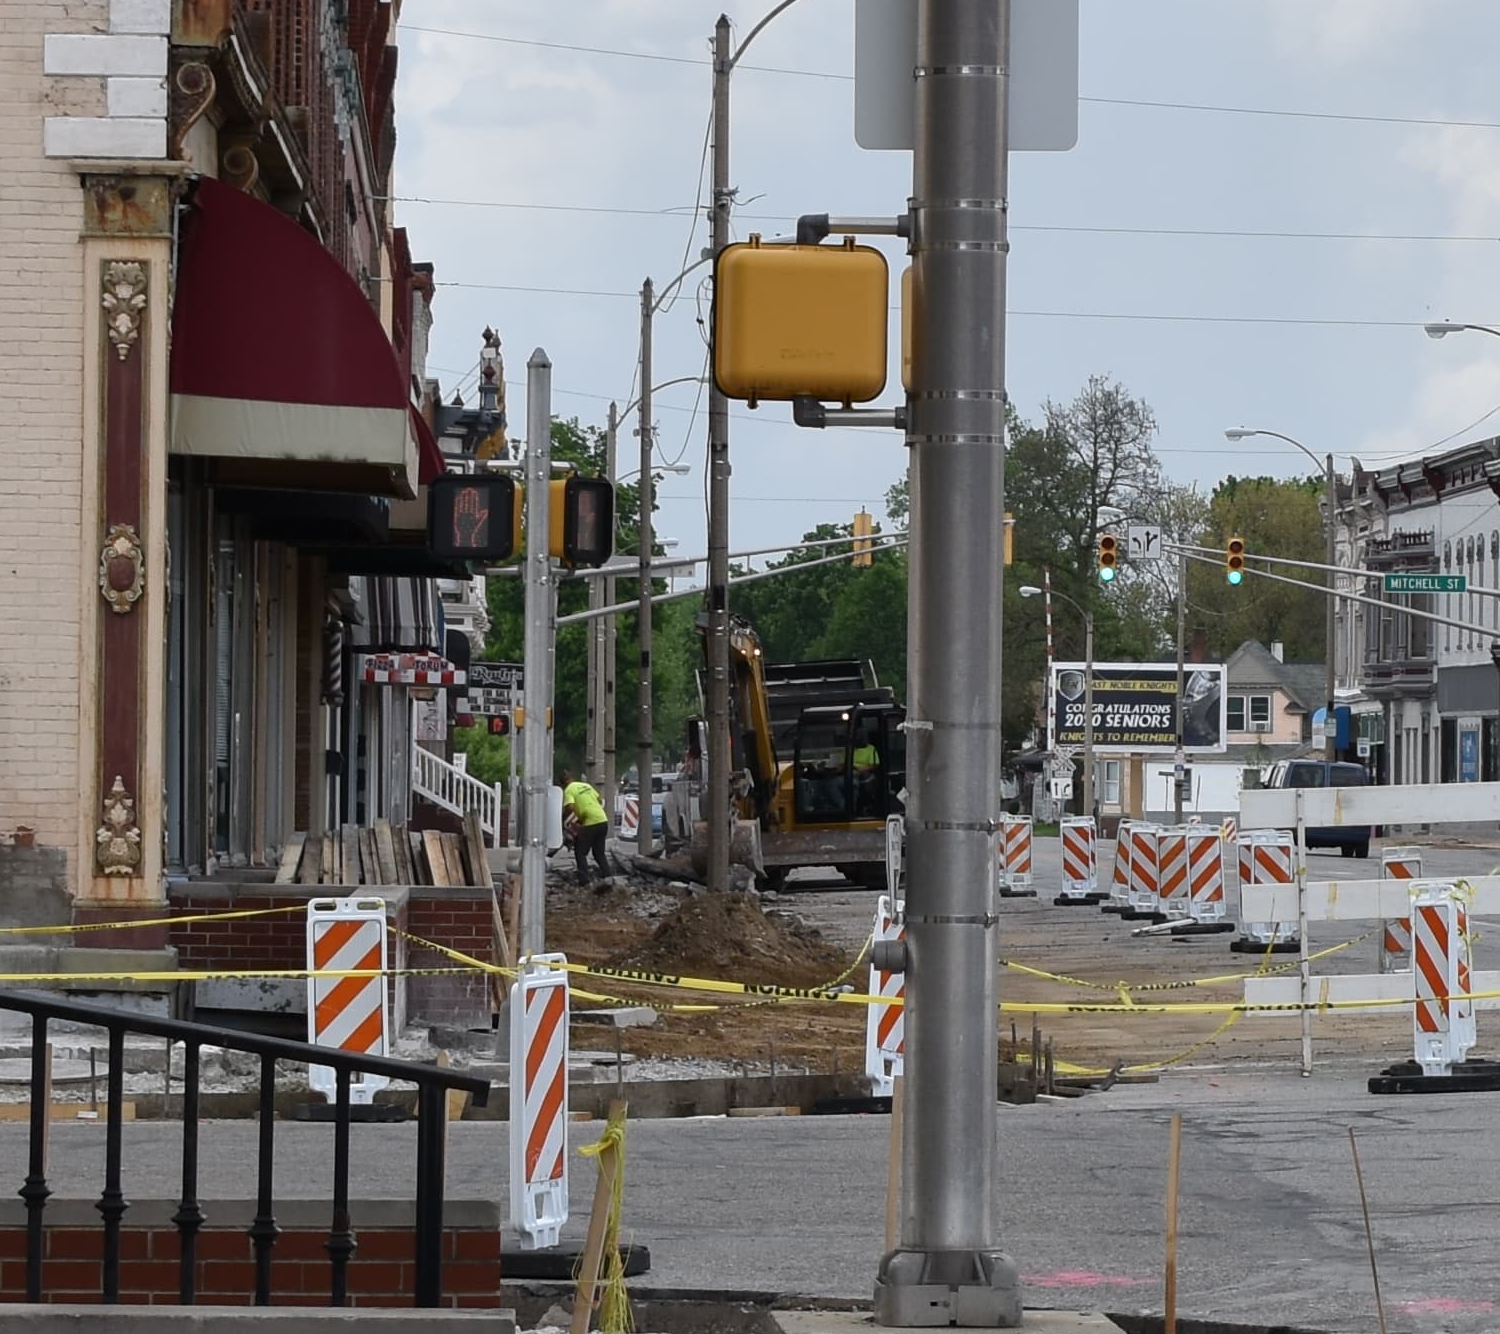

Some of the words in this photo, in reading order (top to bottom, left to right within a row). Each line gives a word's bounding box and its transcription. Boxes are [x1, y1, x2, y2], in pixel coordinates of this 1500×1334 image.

[1390, 578, 1441, 590] MITCHELL
[1446, 578, 1460, 590] ST
[1092, 681, 1107, 689] AST
[1139, 681, 1178, 690] KNIGHTS
[1105, 714, 1171, 728] SENIORS
[1059, 732, 1104, 742] KNIGTS
[1107, 732, 1120, 742] TO
[1123, 733, 1177, 743] REMEMBER
